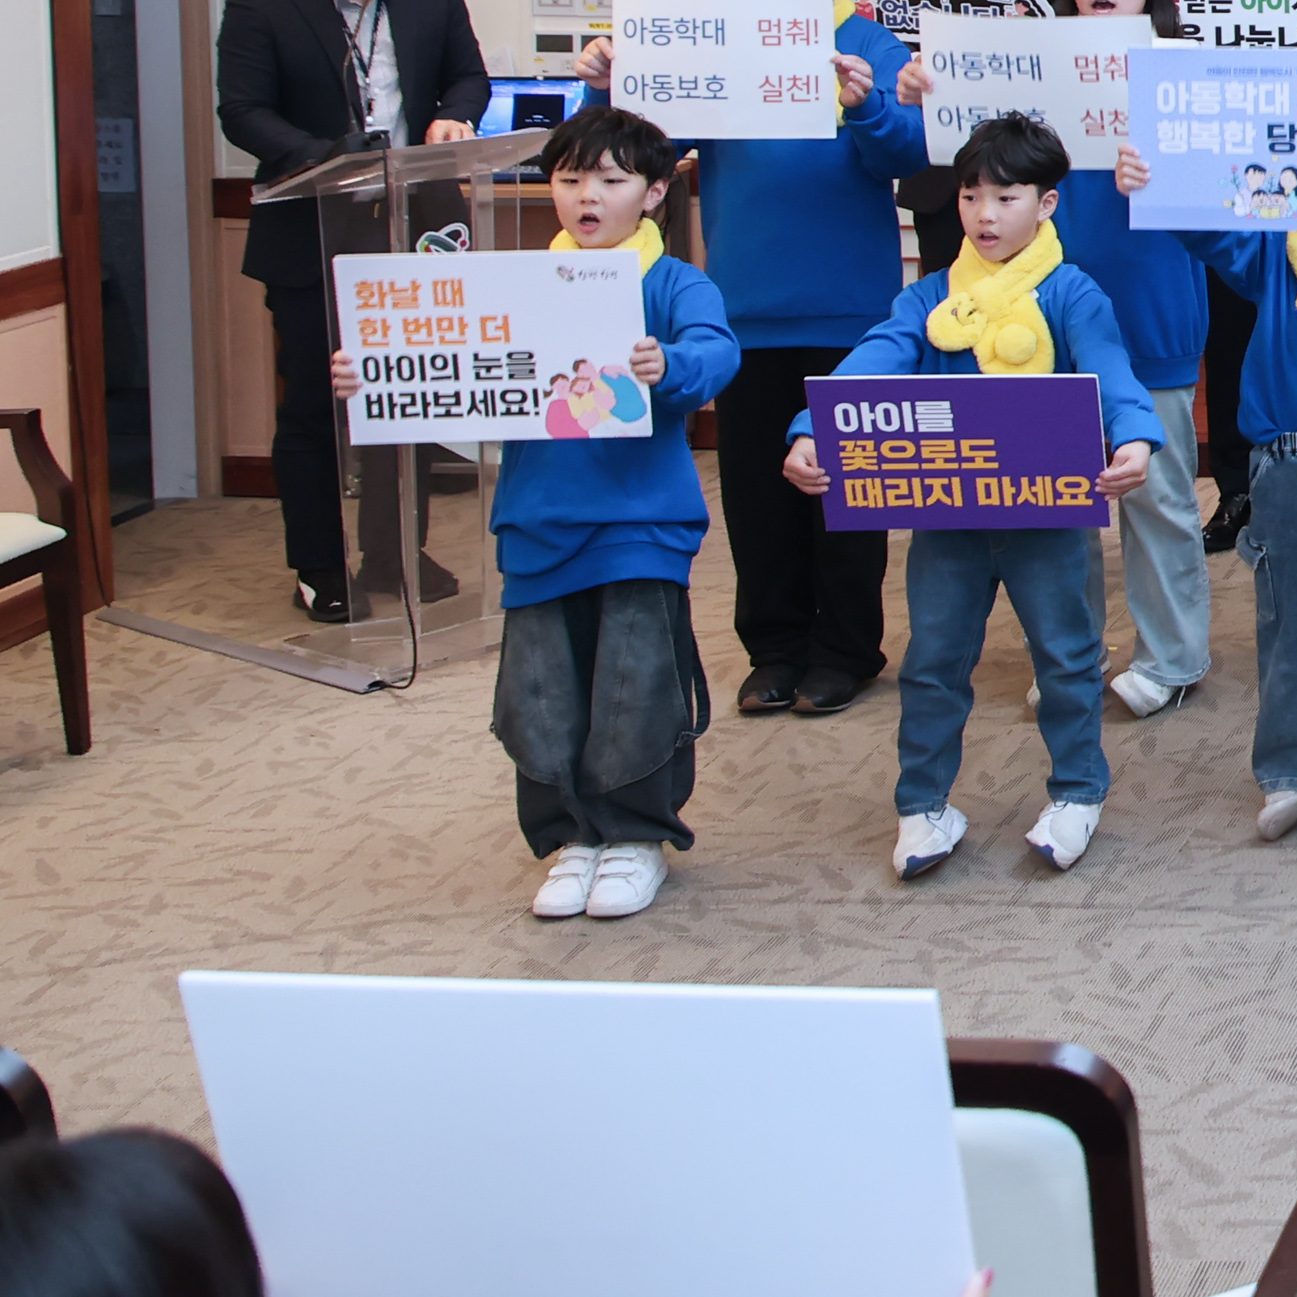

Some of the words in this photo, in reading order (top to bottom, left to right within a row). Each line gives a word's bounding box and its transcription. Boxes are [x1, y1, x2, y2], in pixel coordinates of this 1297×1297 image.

[623, 17, 726, 47] 아동학대
[757, 17, 820, 46] 멈춰!
[932, 50, 1043, 82] 아동학대
[1074, 54, 1128, 83] 멈춰
[623, 74, 728, 102] 아동보호
[758, 73, 820, 102] 실천!
[1156, 80, 1291, 116] 아동학대
[1156, 119, 1257, 155] 행복한
[354, 278, 422, 310] 화날
[432, 278, 465, 308] 때
[358, 316, 391, 347] 한
[402, 315, 468, 346] 번만
[480, 314, 511, 344] 더
[362, 353, 460, 383] 아이의
[473, 351, 537, 381] 눈을
[366, 389, 540, 420] 바라보세요!
[834, 400, 954, 434] 아이를
[838, 439, 1000, 471] 꽃으로도
[843, 476, 963, 509] 때리지
[975, 475, 1094, 507] 마세요
